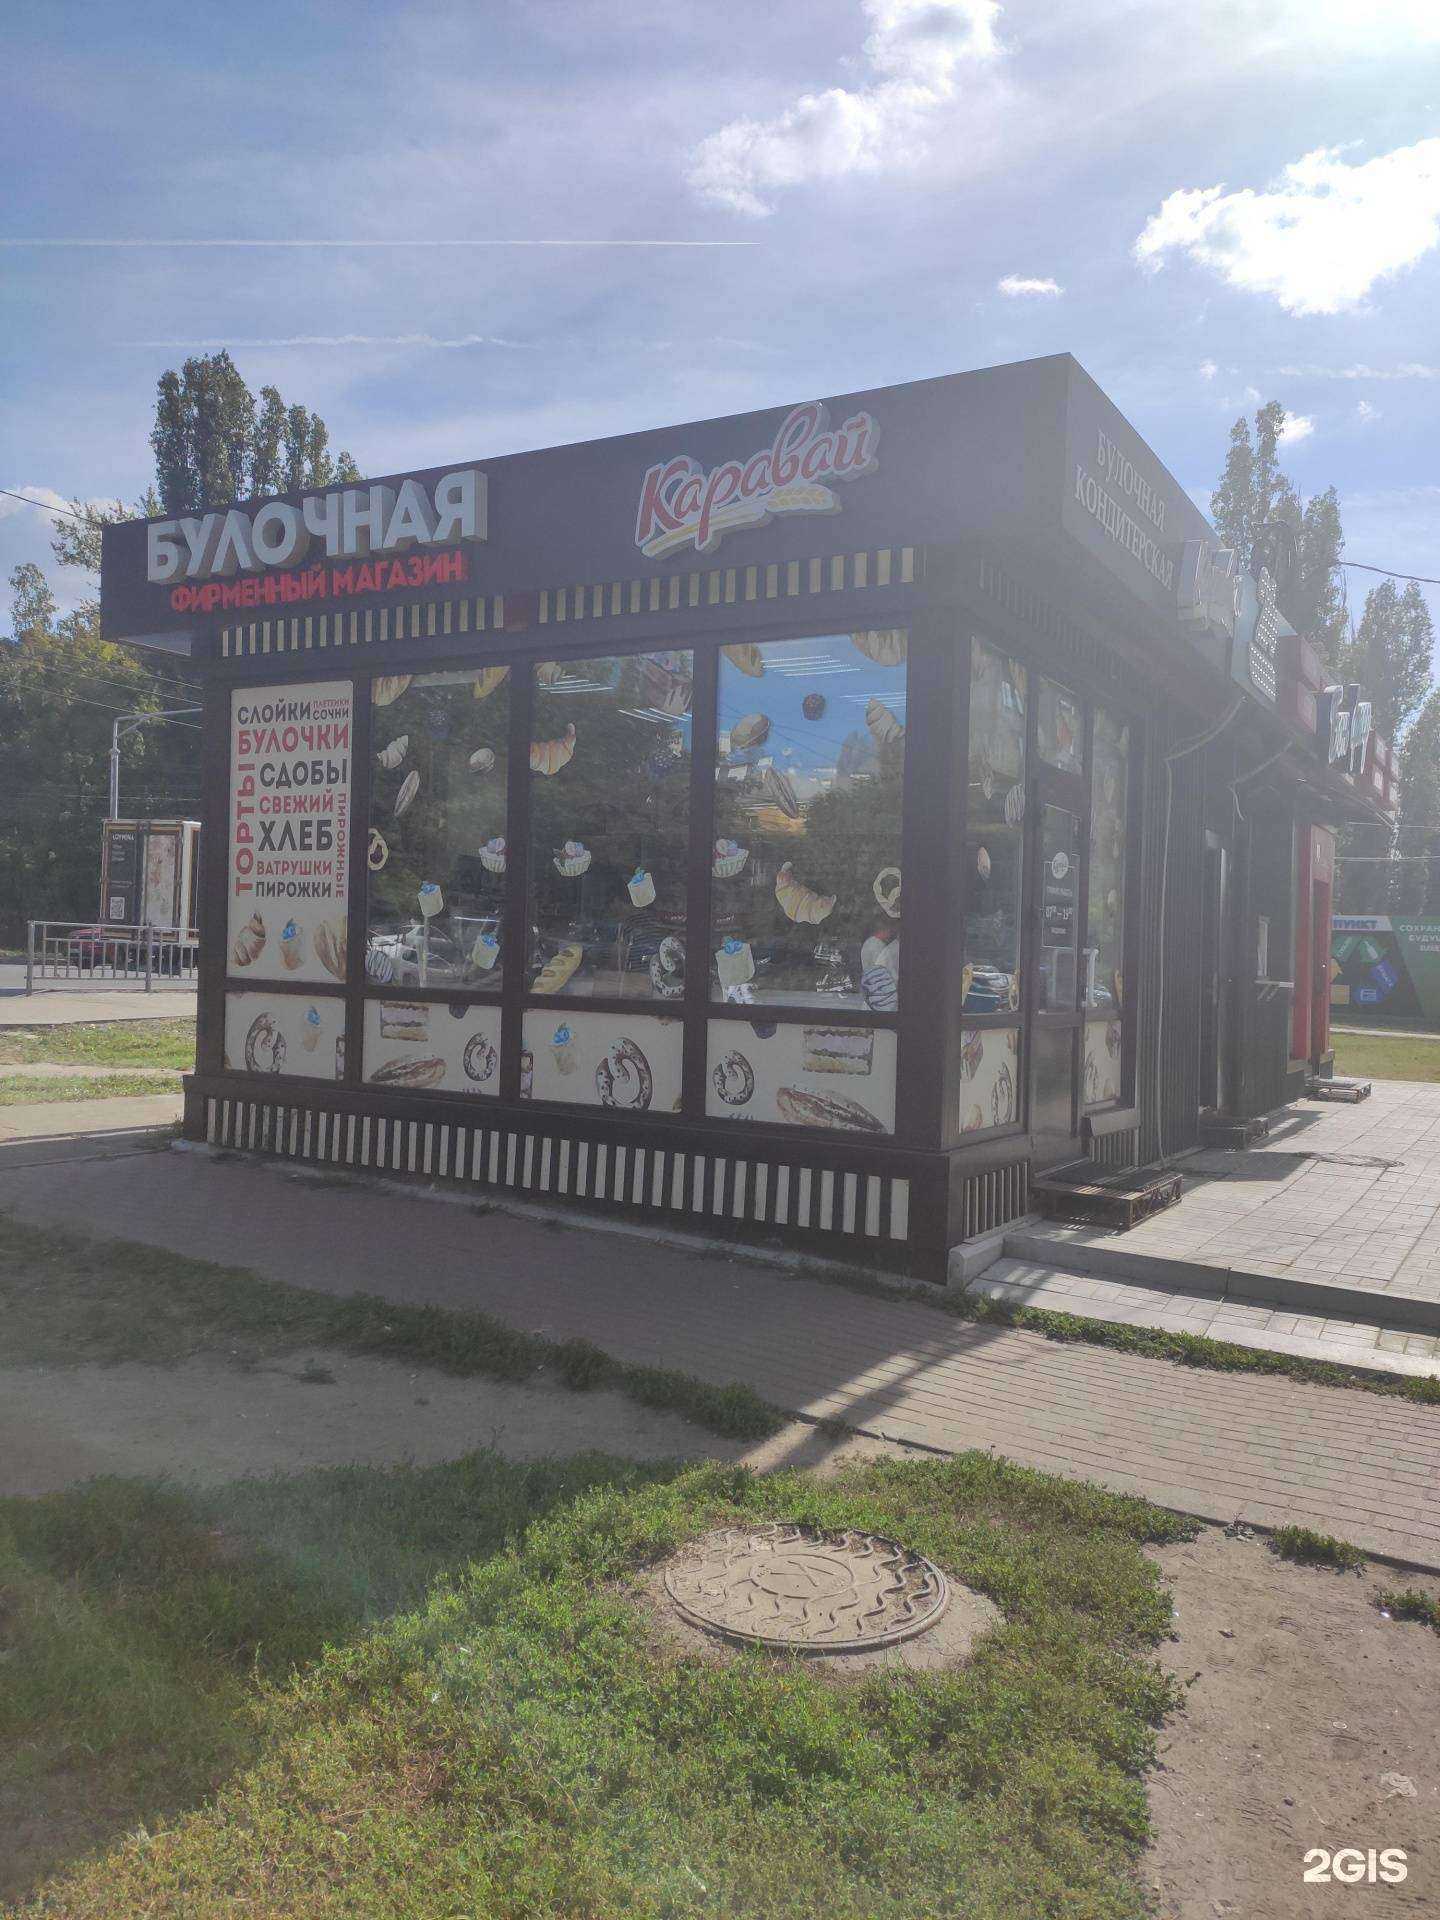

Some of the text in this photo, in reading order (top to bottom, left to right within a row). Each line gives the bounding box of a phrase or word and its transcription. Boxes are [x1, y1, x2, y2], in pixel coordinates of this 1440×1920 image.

[635, 401, 880, 551] Каравай
[1096, 428, 1167, 533] БУЛОЧНАЯ
[148, 469, 487, 584] БУЛОЧНАЯ
[1074, 464, 1176, 591] КОНДИТЕРСКАЯ
[170, 551, 467, 613] ФИРМЕННЫЙ МАГАЗИН
[237, 698, 311, 725] СЛОЙКИ
[313, 708, 349, 721] СОЧНИ
[238, 723, 350, 755] БУЛОЧКИ
[259, 758, 347, 789] СДОБЫ
[259, 788, 334, 815] СВЕЖИЙ
[235, 763, 255, 896] ТОРТЫ
[258, 819, 333, 852] ХЛЕБ
[335, 792, 347, 898] ПИРОЖНЫЕ
[256, 860, 332, 876] ВАТРУШКИ
[256, 881, 332, 898] ПИРОЖКИ
